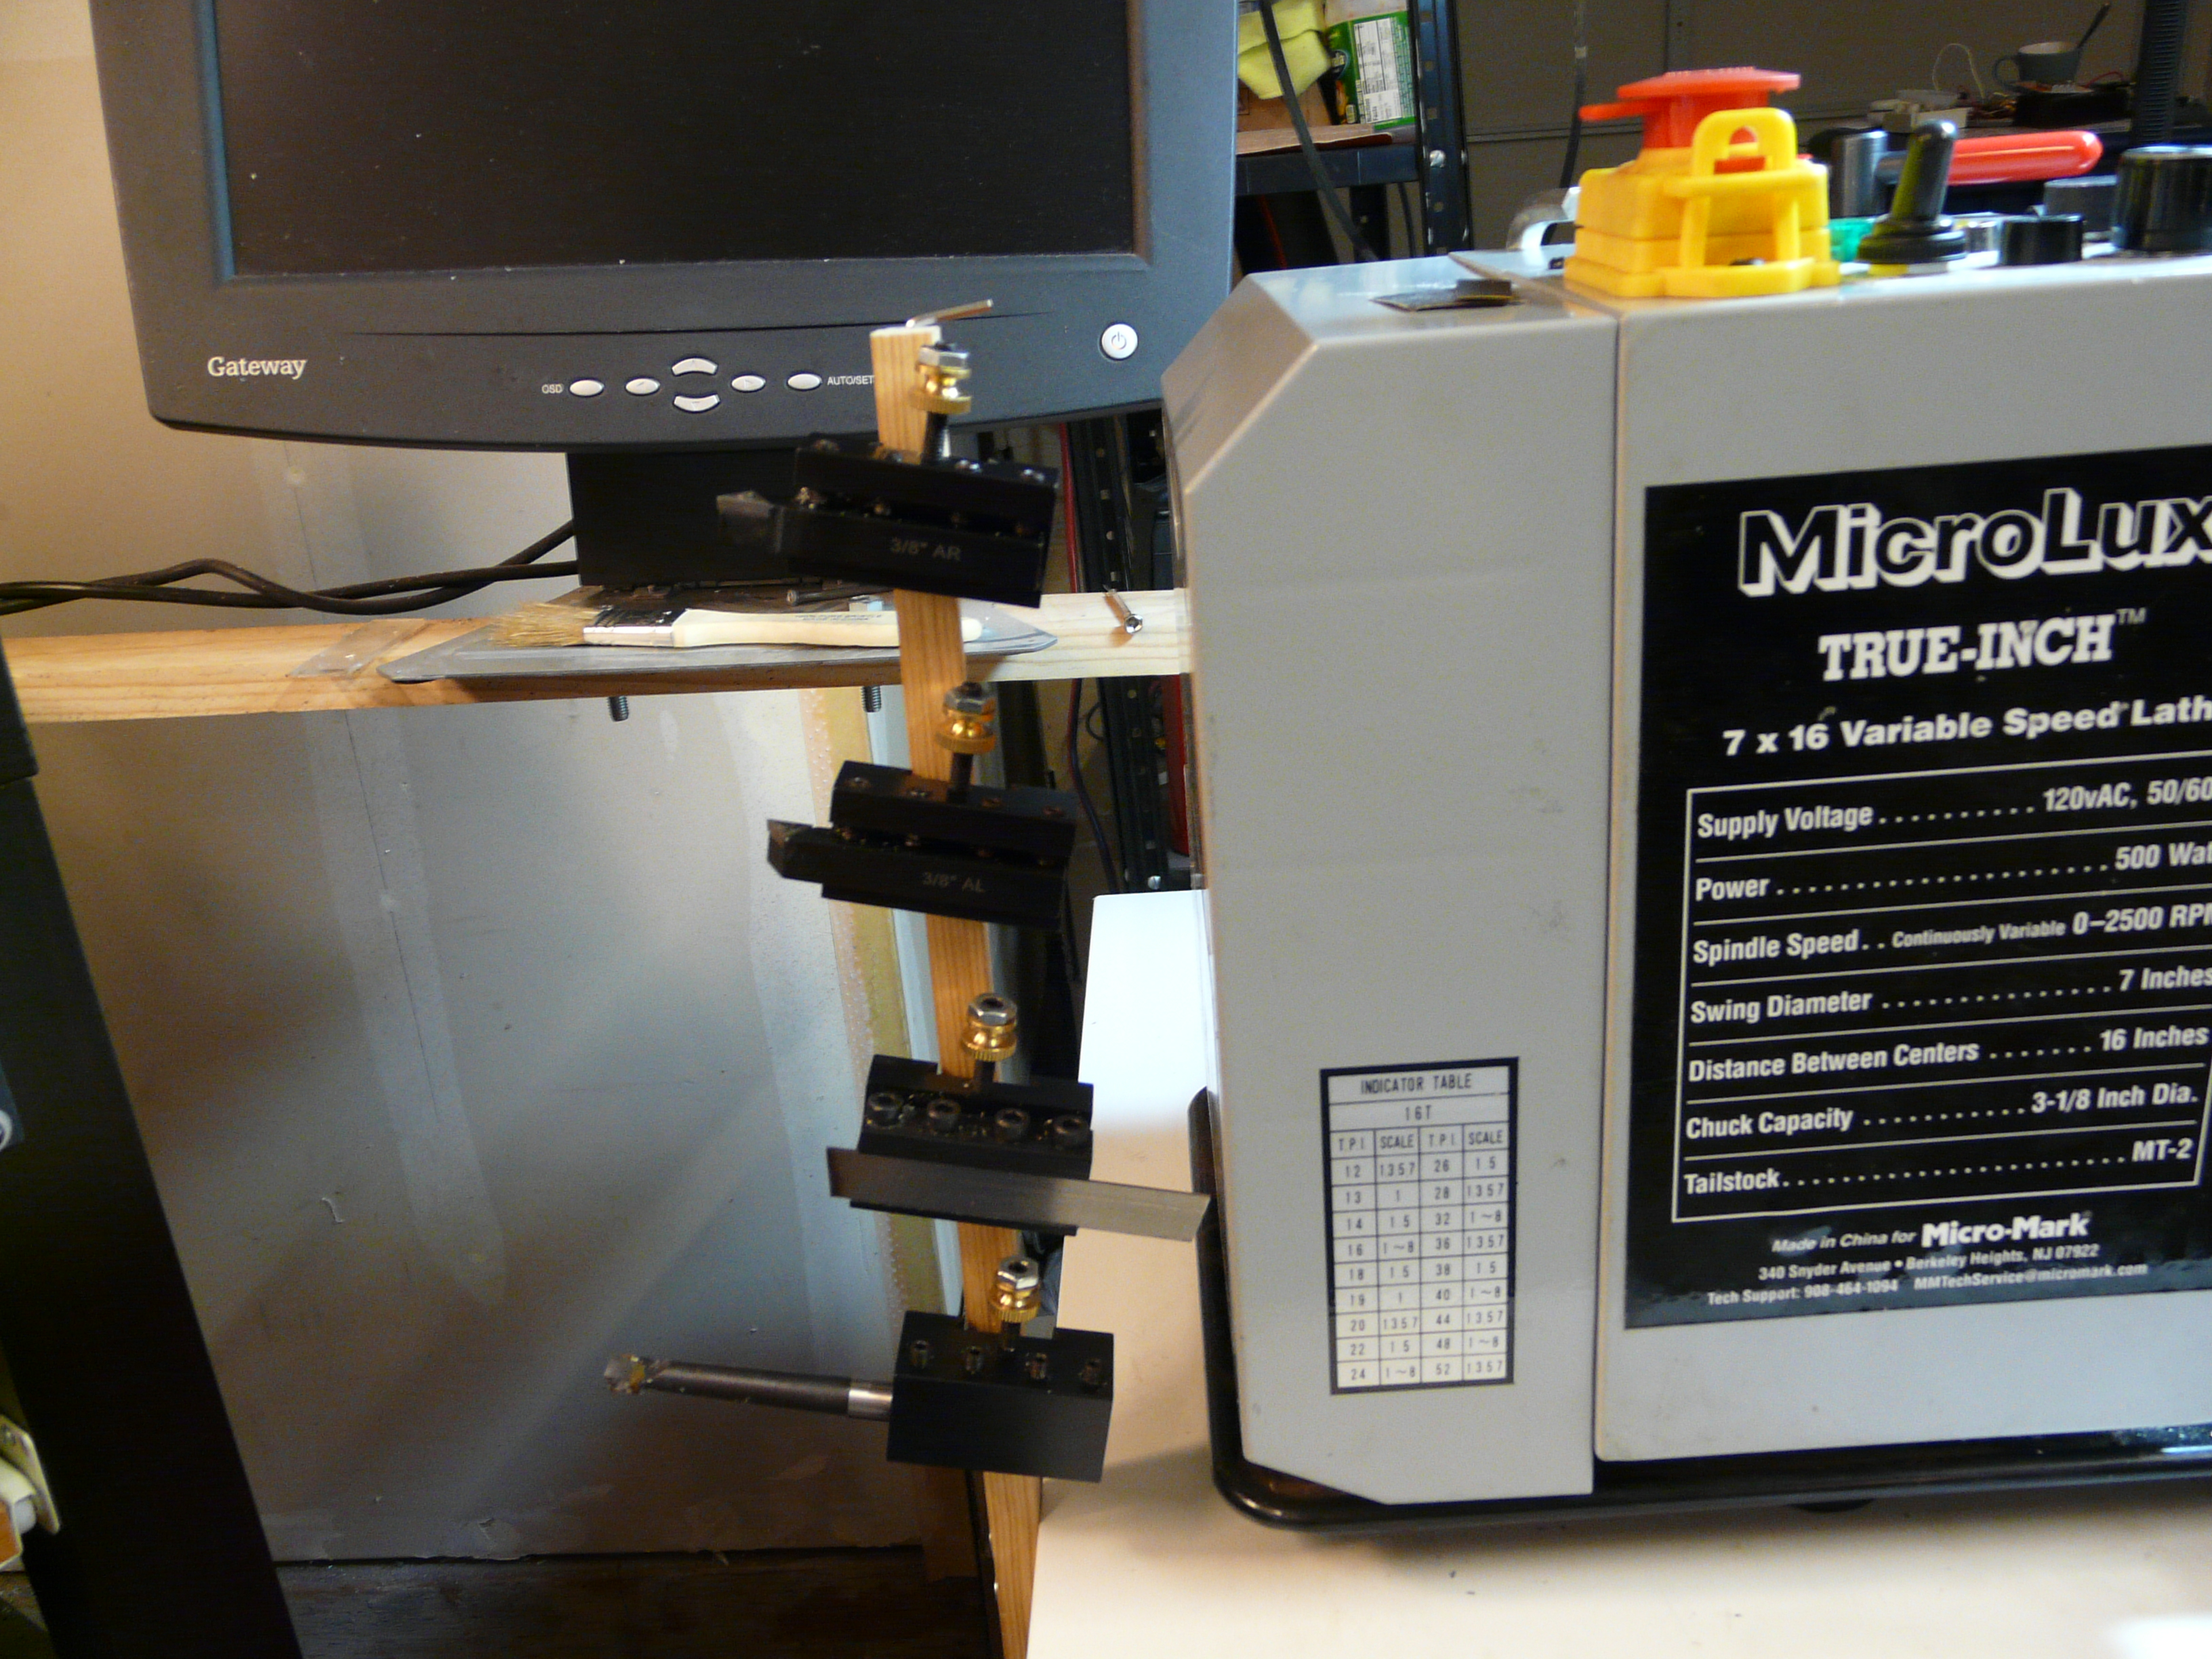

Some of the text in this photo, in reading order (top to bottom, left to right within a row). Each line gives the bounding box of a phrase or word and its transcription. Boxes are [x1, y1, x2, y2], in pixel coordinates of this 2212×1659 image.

[207, 356, 307, 379] Gateway
[542, 384, 564, 394] OSD
[827, 375, 874, 385] AUTO/SET
[932, 543, 961, 561] AR
[1738, 487, 2212, 597] MicroLux
[1819, 615, 2116, 680] TRUE-INCH
[1723, 695, 2212, 756] 7 x 16 Variable Speed Lath
[1698, 811, 1778, 840] Supply
[1784, 806, 1874, 832] Voltage
[2043, 783, 2138, 811] 120vAC,
[1695, 877, 1769, 901] Power
[2115, 845, 2161, 869] 500
[962, 877, 985, 893] AL
[1694, 935, 1780, 966] Spindle
[1786, 930, 1860, 959] Speed
[1892, 925, 1995, 948] Continuously
[1999, 920, 2067, 941] Variable
[1690, 966, 2212, 1025] Swing Diameter 7 Inches
[1689, 1025, 2209, 1082] Distance Between Centers 16 Inches
[1361, 1073, 1472, 1094] INDICATOR TABLE
[1406, 1105, 1431, 1120] 16T
[1686, 1084, 2199, 1140] Chuck Capacity 3-1/8 Inch Dia.
[1380, 1134, 1414, 1148] SCALE
[1468, 1130, 1503, 1145] SCALE
[1346, 1165, 1361, 1178] 12
[1434, 1159, 1450, 1172] 26
[1684, 1139, 2193, 1195] Tailstock MT-2
[1346, 1191, 1361, 1204] 13
[1396, 1190, 1400, 1202] 1
[1435, 1187, 1450, 1200] 28
[1347, 1218, 1362, 1231] 14
[1435, 1212, 1450, 1225] 32
[1771, 1212, 2089, 1252] Made in China for Micro-Mark
[1349, 1244, 1362, 1256] 16
[1435, 1237, 1450, 1250] 36
[1350, 1269, 1364, 1281] 18
[1436, 1263, 1450, 1275] 38
[1758, 1265, 1785, 1281] 340
[1788, 1263, 1837, 1279] Snyder
[1840, 1260, 1891, 1275] Avenue
[1905, 1254, 1967, 1270] Berkeley
[2032, 1246, 2052, 1260] NJ
[2055, 1243, 2100, 1258] 07922
[1708, 1291, 1740, 1305] Tech
[1742, 1288, 1800, 1303] Support:
[1914, 1263, 2148, 1290] MMTechService@micromark.com
[1350, 1294, 1365, 1307] 19
[1399, 1292, 1402, 1304] 1
[1435, 1289, 1450, 1301] 40
[1351, 1319, 1365, 1332] 20
[1435, 1313, 1450, 1325] 44
[1351, 1343, 1365, 1355] 22
[1437, 1338, 1450, 1350] 48
[1351, 1369, 1366, 1380] 24
[1436, 1363, 1450, 1375] 52
